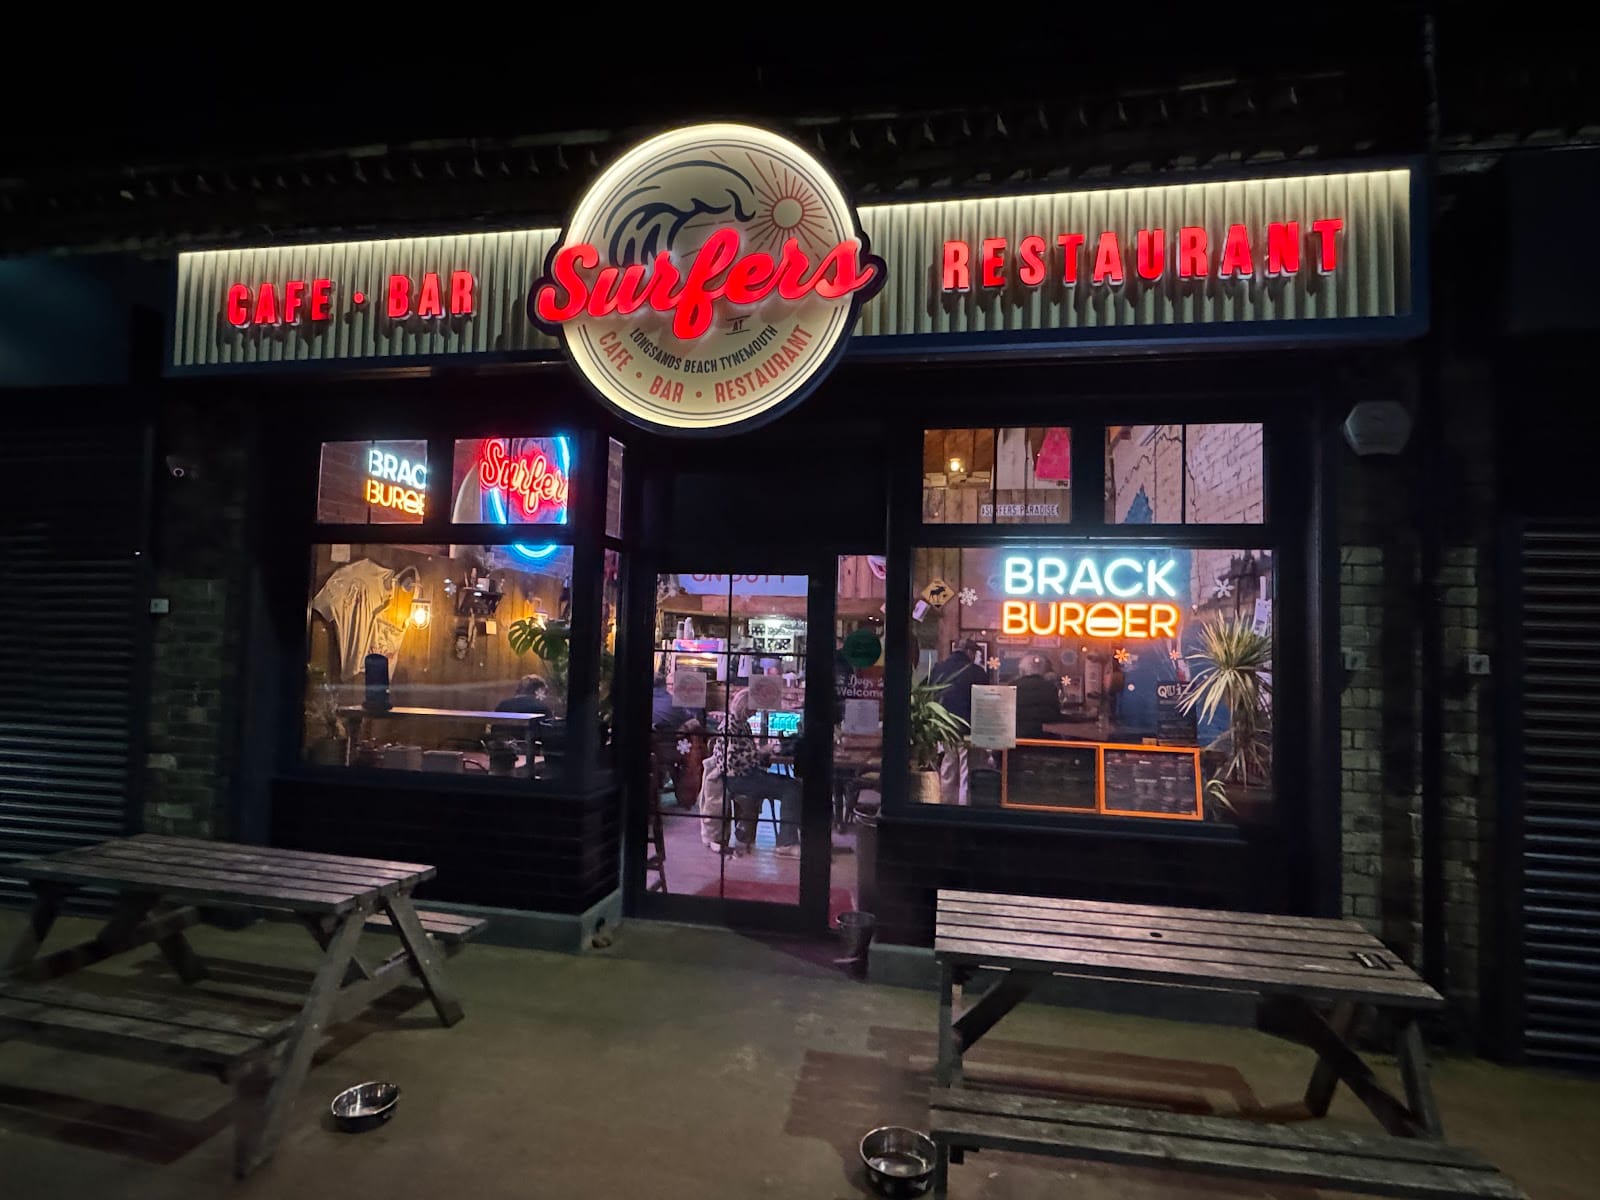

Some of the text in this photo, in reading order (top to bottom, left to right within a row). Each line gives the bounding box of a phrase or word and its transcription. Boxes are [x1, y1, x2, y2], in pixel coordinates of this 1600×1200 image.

[942, 218, 1343, 291] RESTAURANT
[227, 270, 474, 327] CAFE BAR
[537, 227, 875, 340] Surfers
[629, 324, 779, 374] LONGSANDS BEACH TYNEMOUTH
[732, 319, 745, 332] AT
[599, 324, 813, 404] CAFE BAR RESTAURANT
[1003, 556, 1177, 598] BRACK
